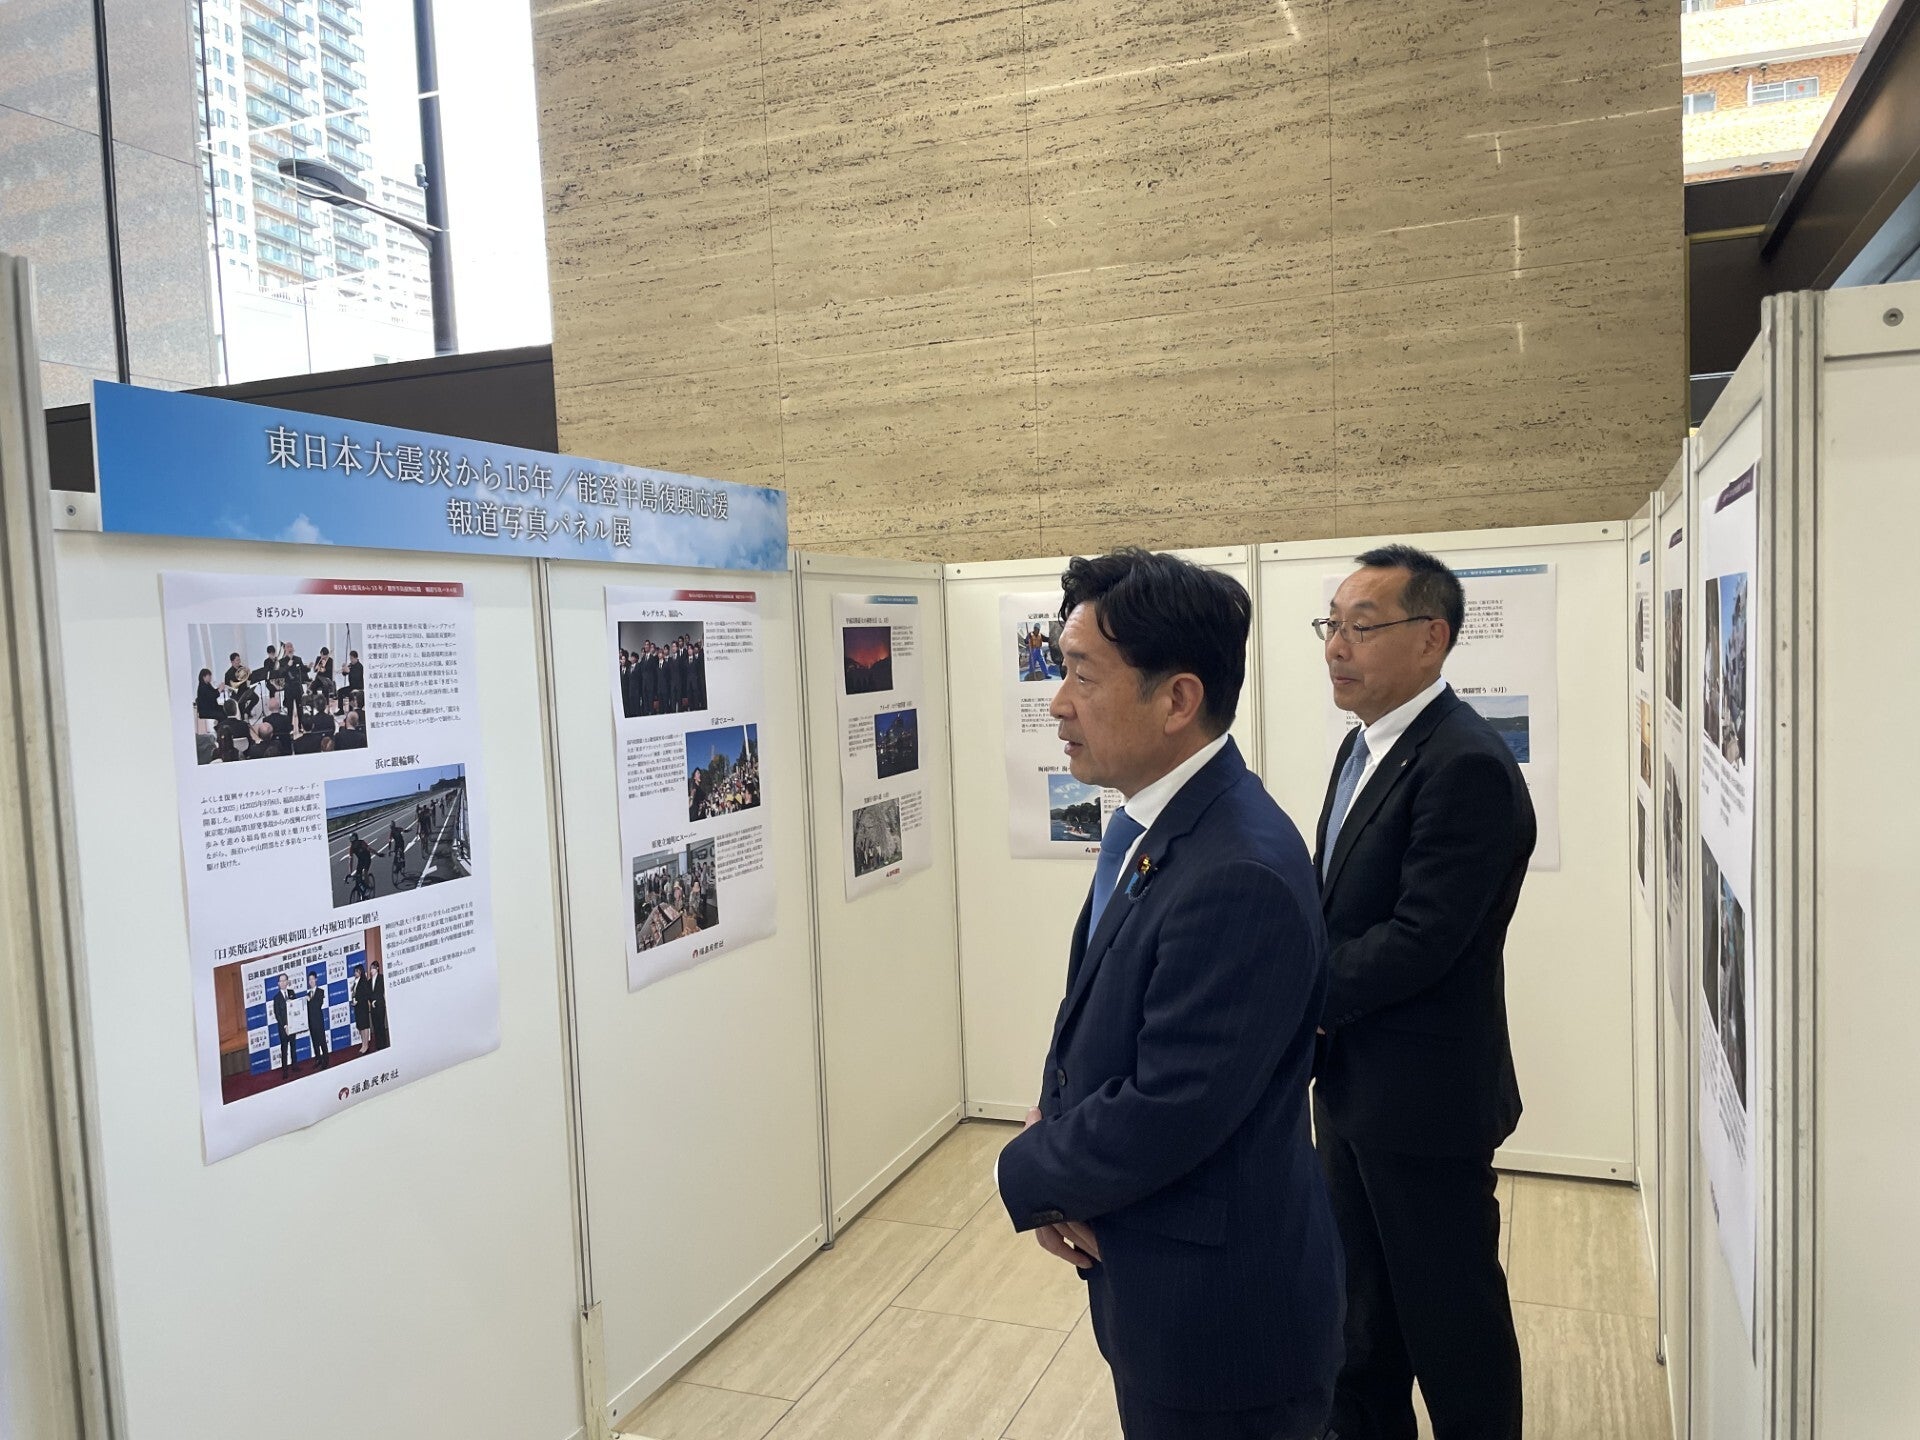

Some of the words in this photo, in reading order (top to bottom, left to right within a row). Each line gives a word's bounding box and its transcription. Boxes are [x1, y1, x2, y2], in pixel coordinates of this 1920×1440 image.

[265, 425, 729, 521] 東日本大震災から15年／能登半島復興応援
[446, 498, 632, 548] 報道写真パネル展
[256, 606, 304, 618] きぼうのとり
